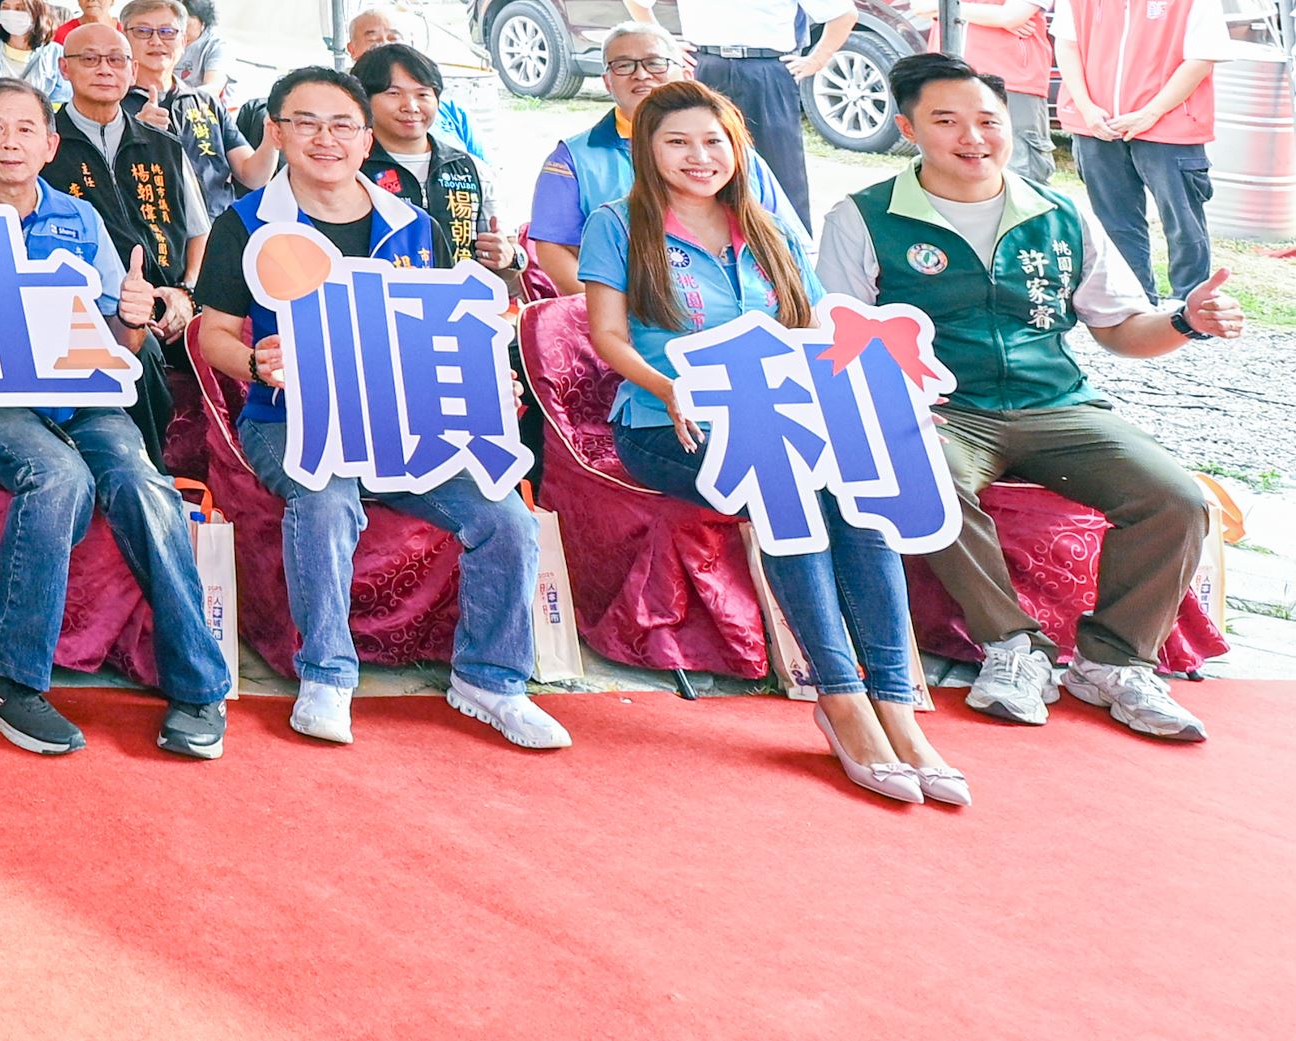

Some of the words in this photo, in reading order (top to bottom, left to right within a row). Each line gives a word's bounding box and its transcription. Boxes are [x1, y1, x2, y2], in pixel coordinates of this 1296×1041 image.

[438, 178, 476, 190] Taoyuan
[1017, 249, 1055, 330] 許家睿
[289, 270, 519, 486] 順
[683, 324, 947, 540] 利
